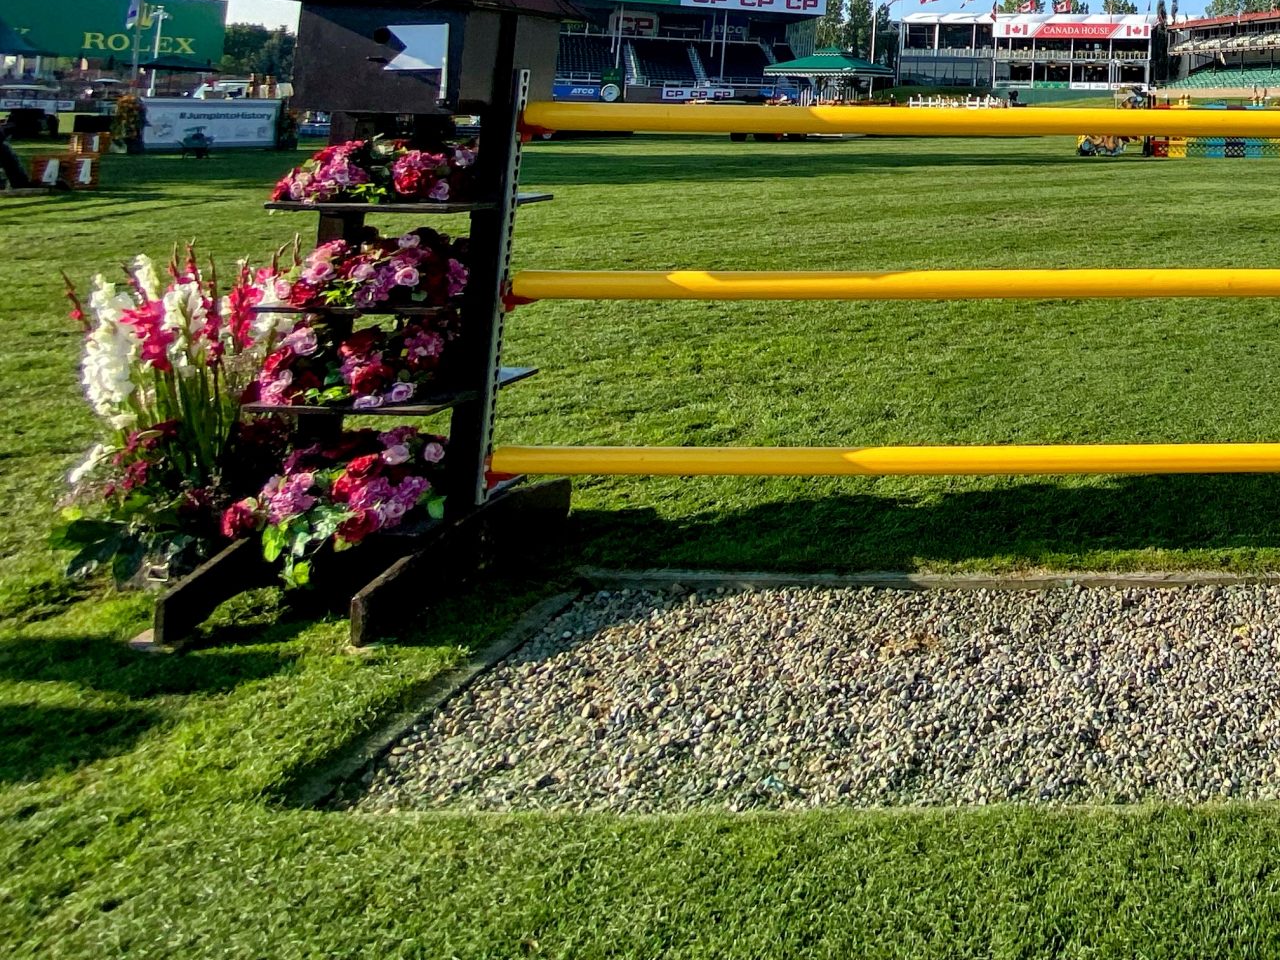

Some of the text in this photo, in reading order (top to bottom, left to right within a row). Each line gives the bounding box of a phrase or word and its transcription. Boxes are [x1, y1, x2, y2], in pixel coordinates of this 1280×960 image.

[1043, 25, 1110, 35] CANADA HOUSE
[81, 31, 196, 54] ROLEX
[690, 90, 707, 98] CP
[179, 112, 272, 121] #JumpIntoHistory
